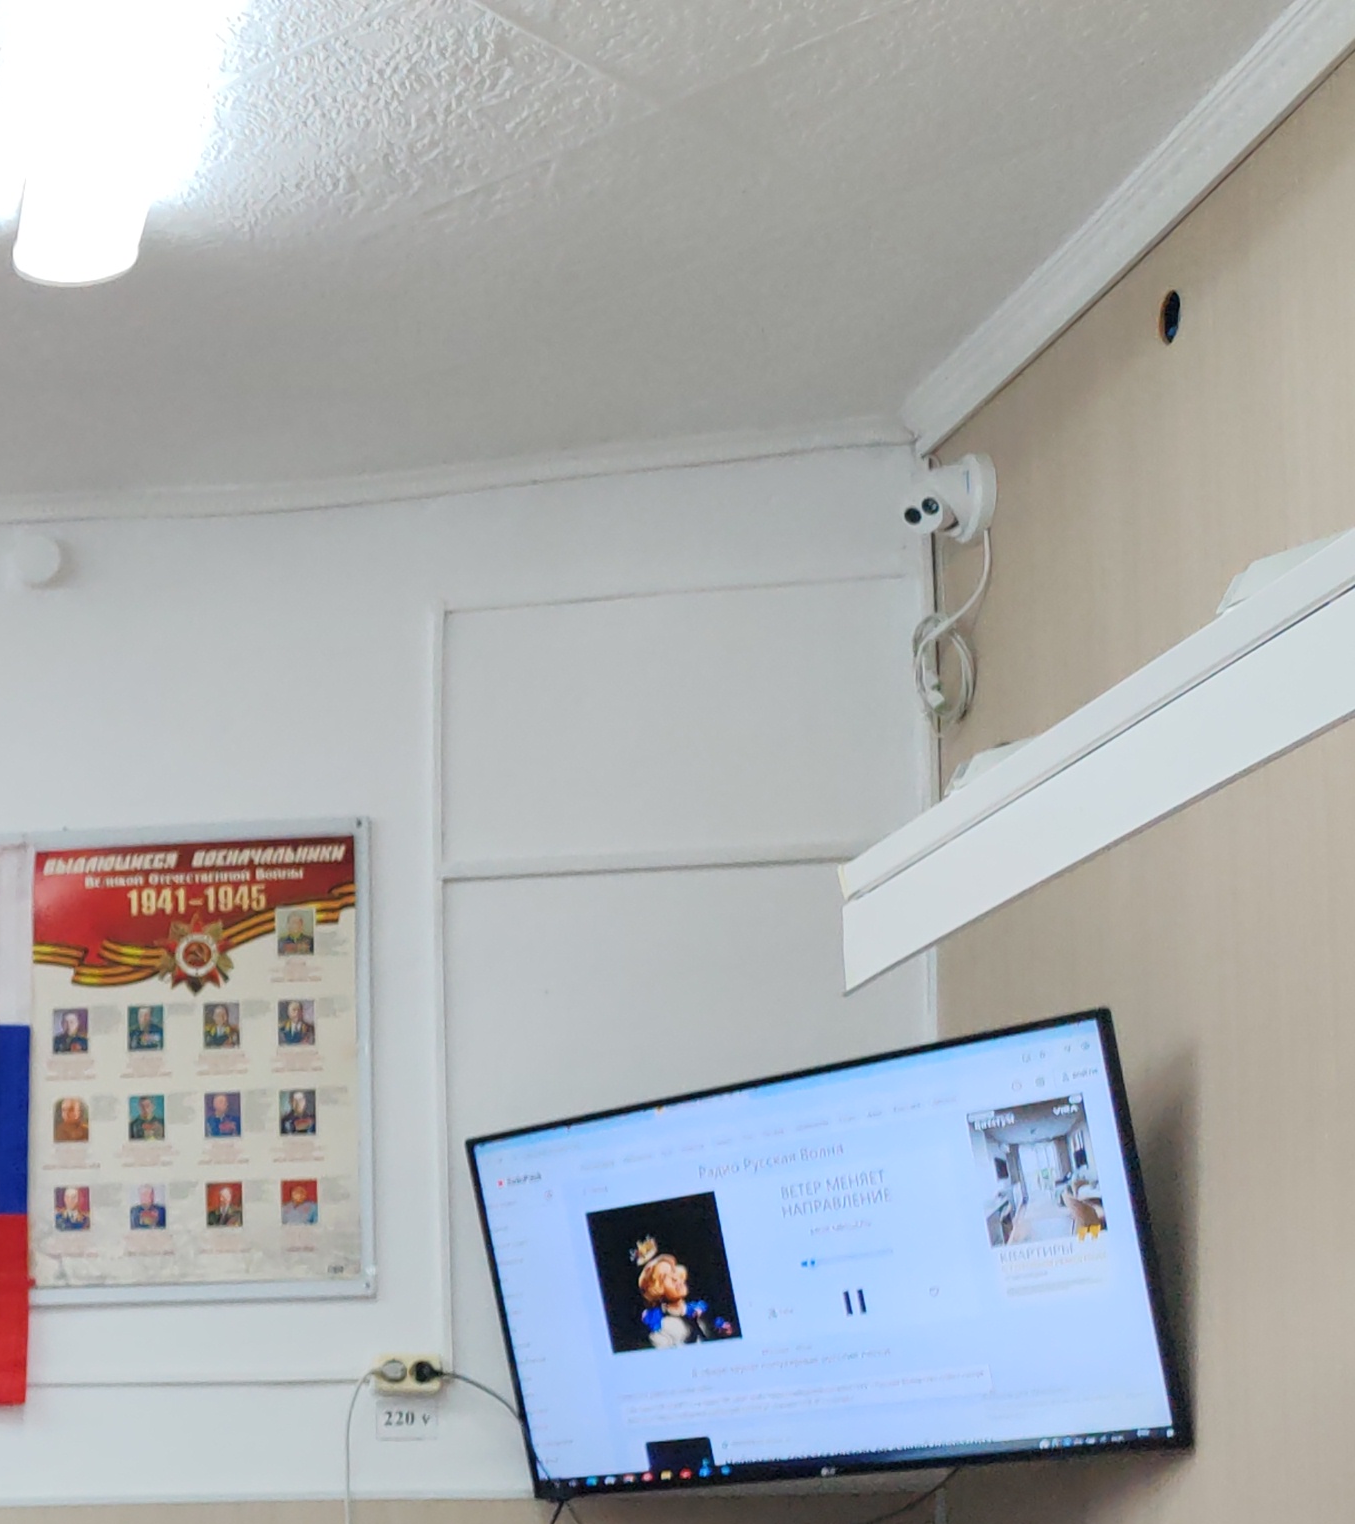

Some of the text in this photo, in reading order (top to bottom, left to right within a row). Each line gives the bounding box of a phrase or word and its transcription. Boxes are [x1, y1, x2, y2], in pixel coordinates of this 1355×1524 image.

[42, 844, 347, 877] ВЫДАЮЩИЕСЯ ВОЕНАЧАЛЬНИКИ
[698, 1143, 845, 1180] Радио Русская Волна
[780, 1169, 885, 1201] ВЕТЕР МЕНЯЕТ
[780, 1187, 892, 1219] НАПРАВЛЕНИЕ
[383, 1410, 415, 1427] 220
